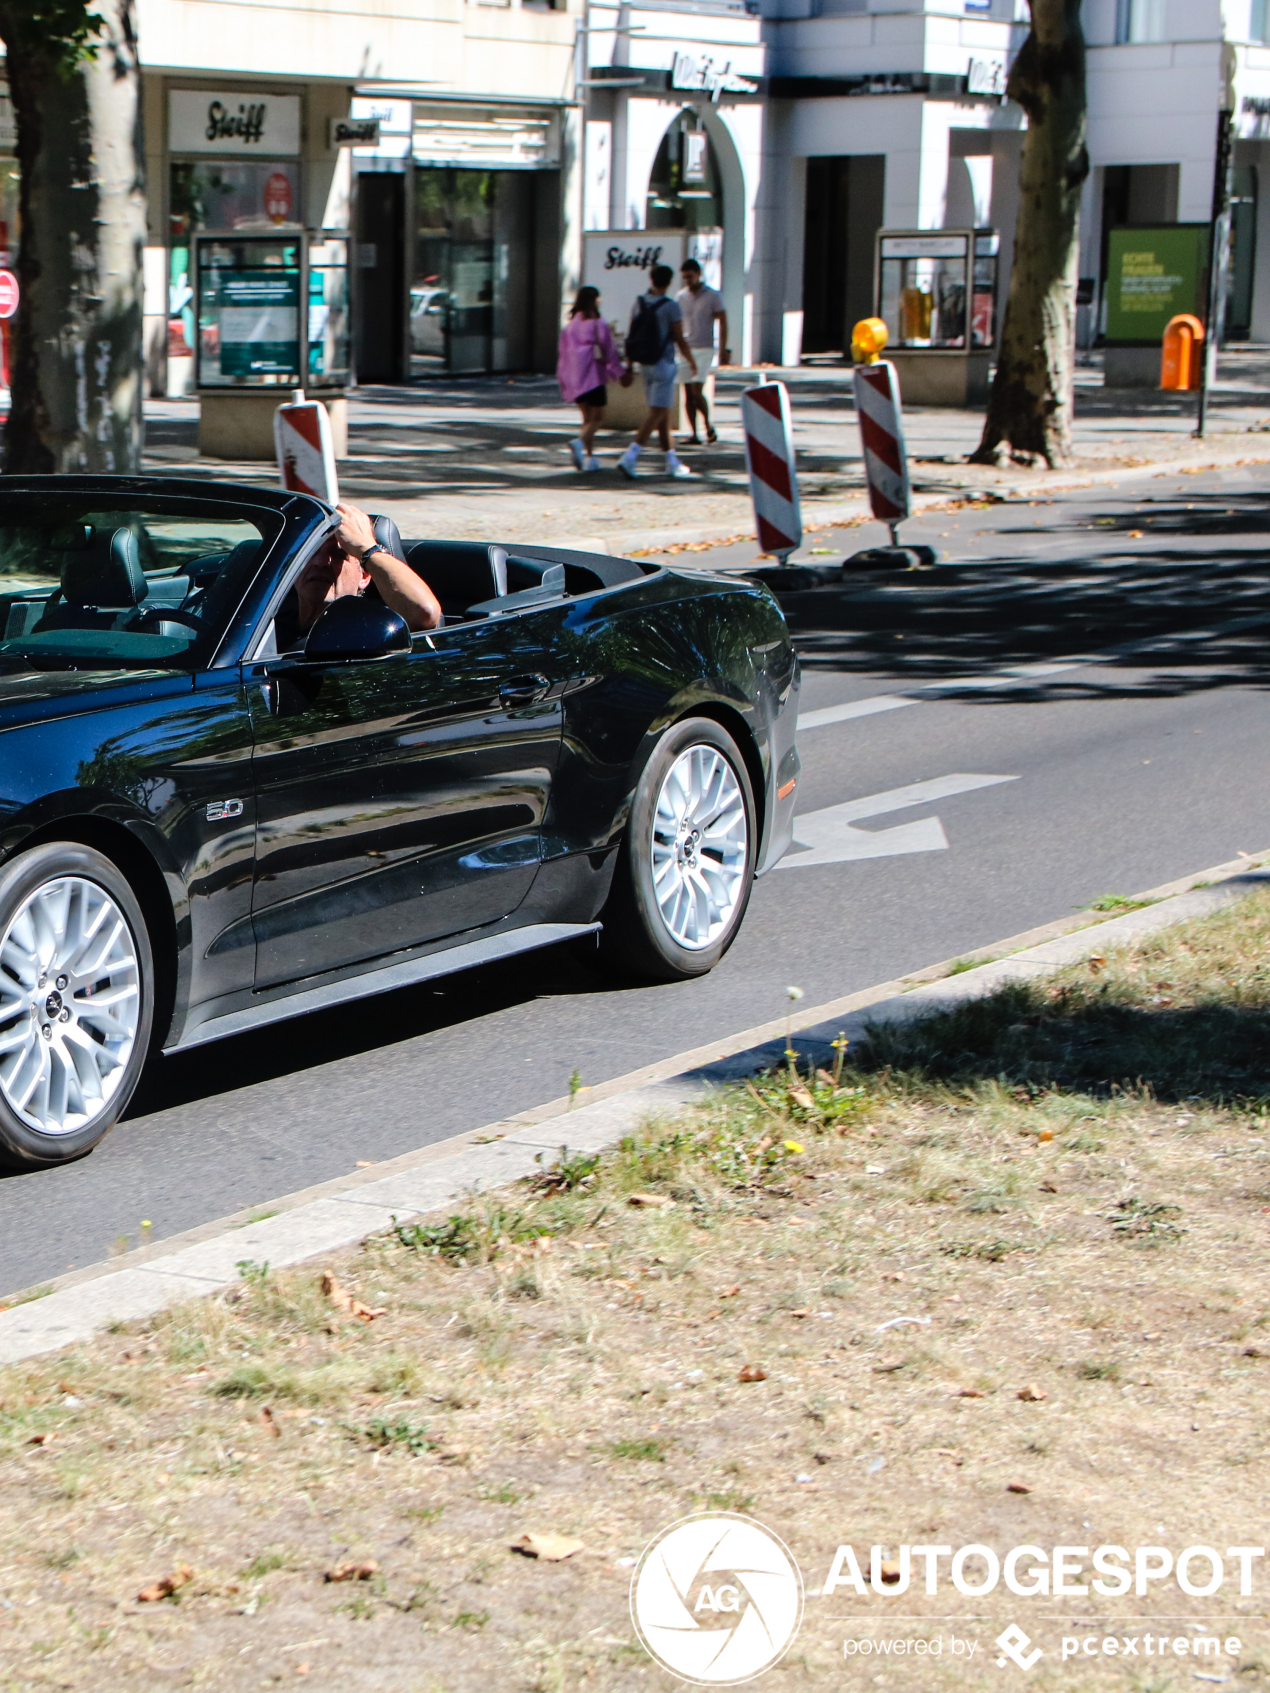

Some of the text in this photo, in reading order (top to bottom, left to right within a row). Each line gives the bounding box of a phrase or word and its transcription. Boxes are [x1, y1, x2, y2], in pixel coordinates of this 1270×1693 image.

[205, 101, 266, 143] Steiff
[335, 123, 376, 142] Steiff
[604, 245, 662, 270] Steiff
[206, 798, 243, 821] 5.0
